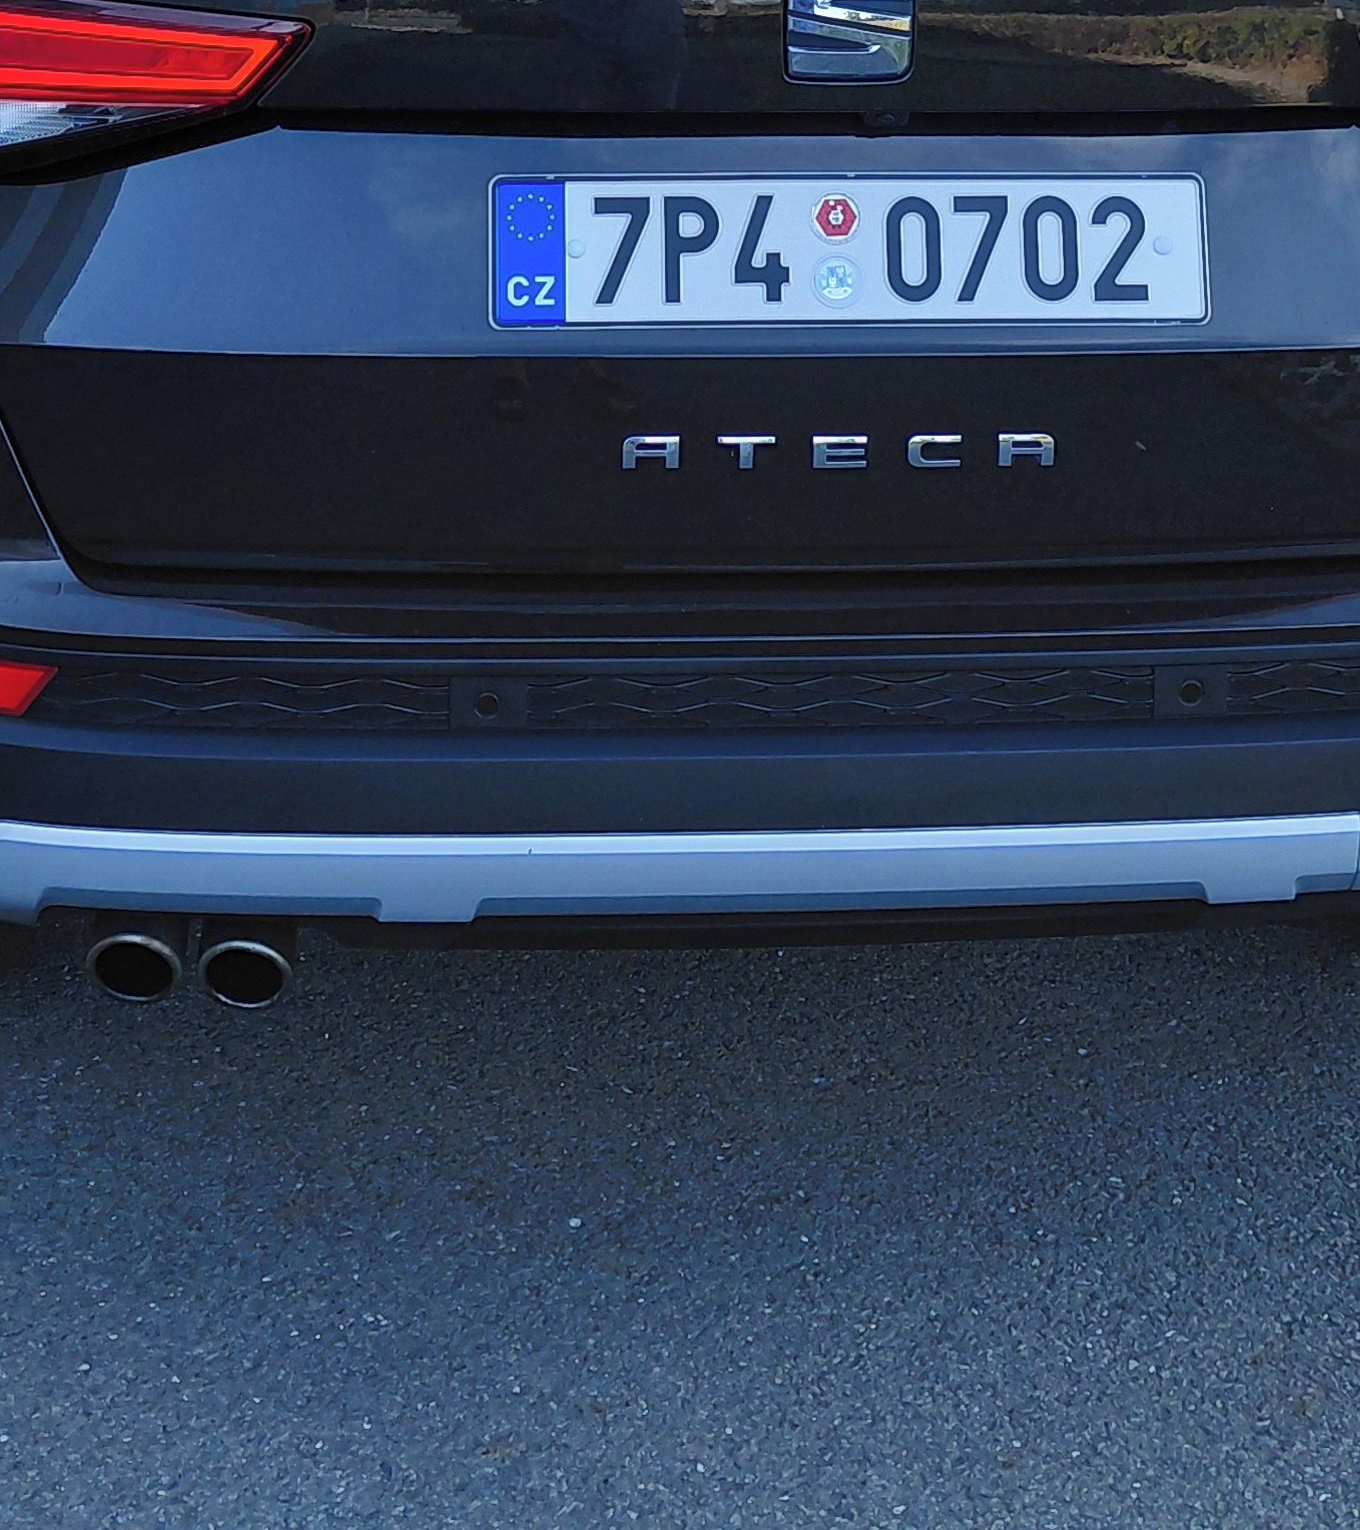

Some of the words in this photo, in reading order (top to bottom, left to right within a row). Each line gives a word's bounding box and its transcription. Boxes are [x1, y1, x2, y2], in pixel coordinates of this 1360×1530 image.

[506, 275, 556, 307] CZ
[592, 194, 791, 305] 7P4
[884, 194, 1150, 304] 0702
[621, 432, 1056, 471] ATECA
